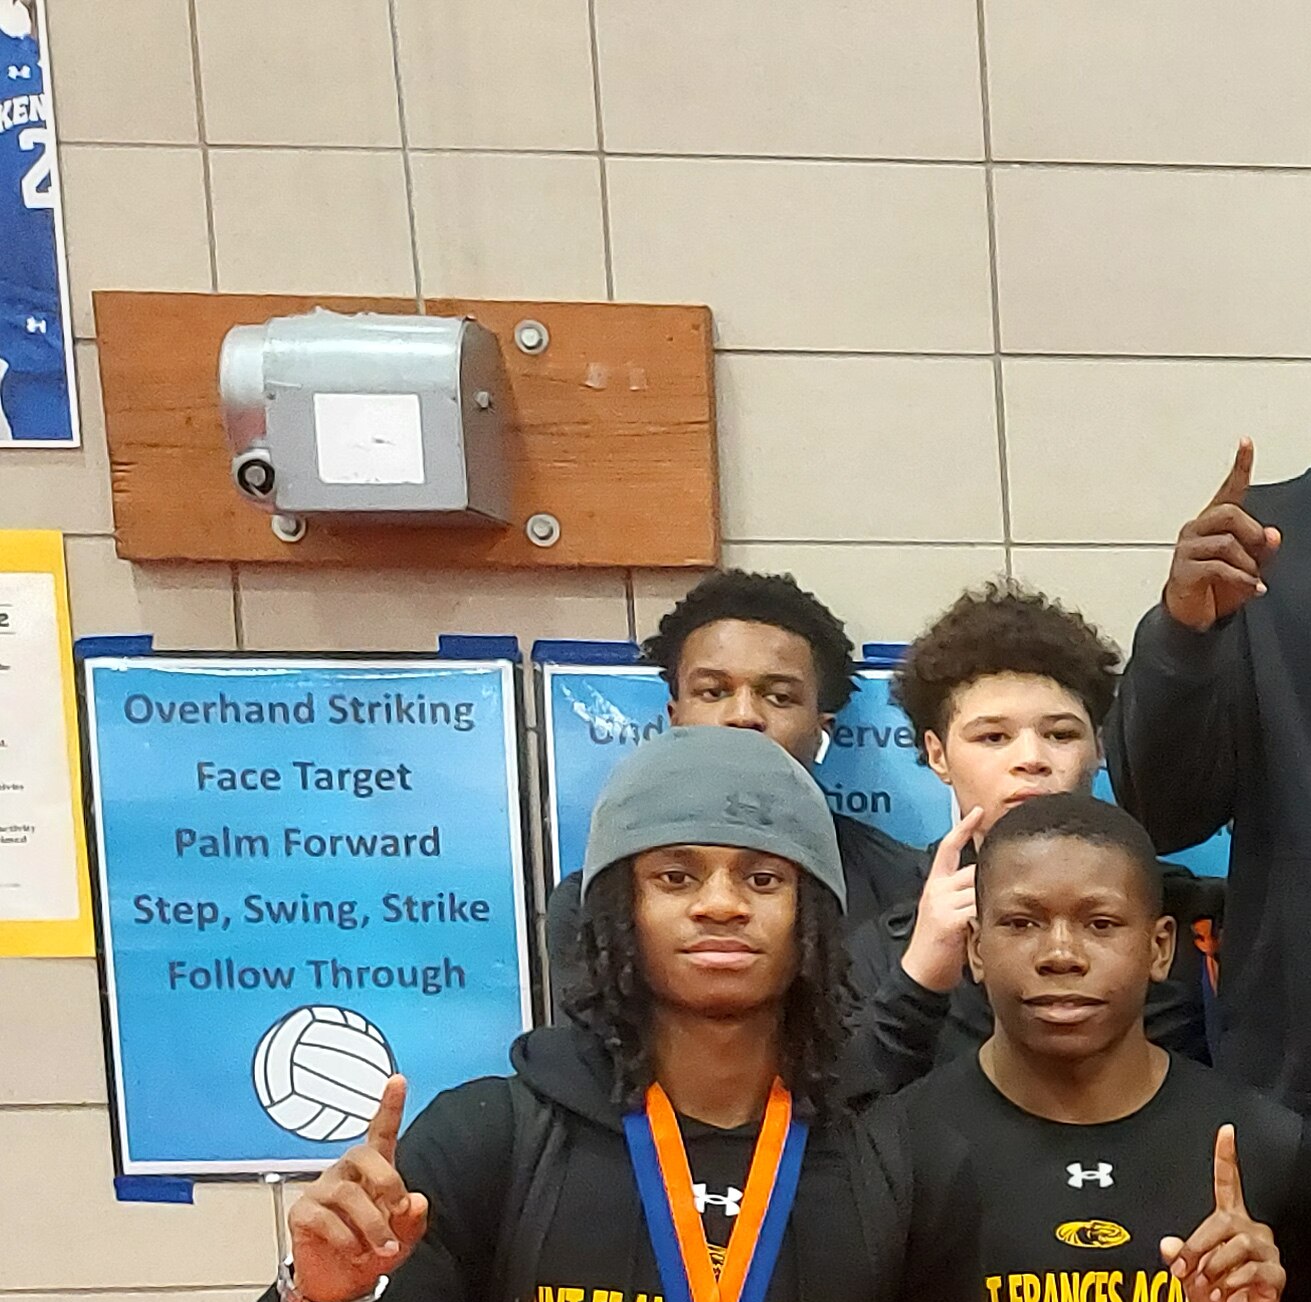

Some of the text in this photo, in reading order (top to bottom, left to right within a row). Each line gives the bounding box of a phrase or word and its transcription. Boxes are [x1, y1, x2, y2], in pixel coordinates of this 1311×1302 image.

[124, 692, 476, 732] Overhand Striking
[830, 724, 915, 749] erve
[197, 761, 414, 798] Face Target
[174, 826, 441, 858] Palm Forward
[132, 893, 491, 931] Step, Swing, Strike
[168, 957, 466, 994] Follow Through
